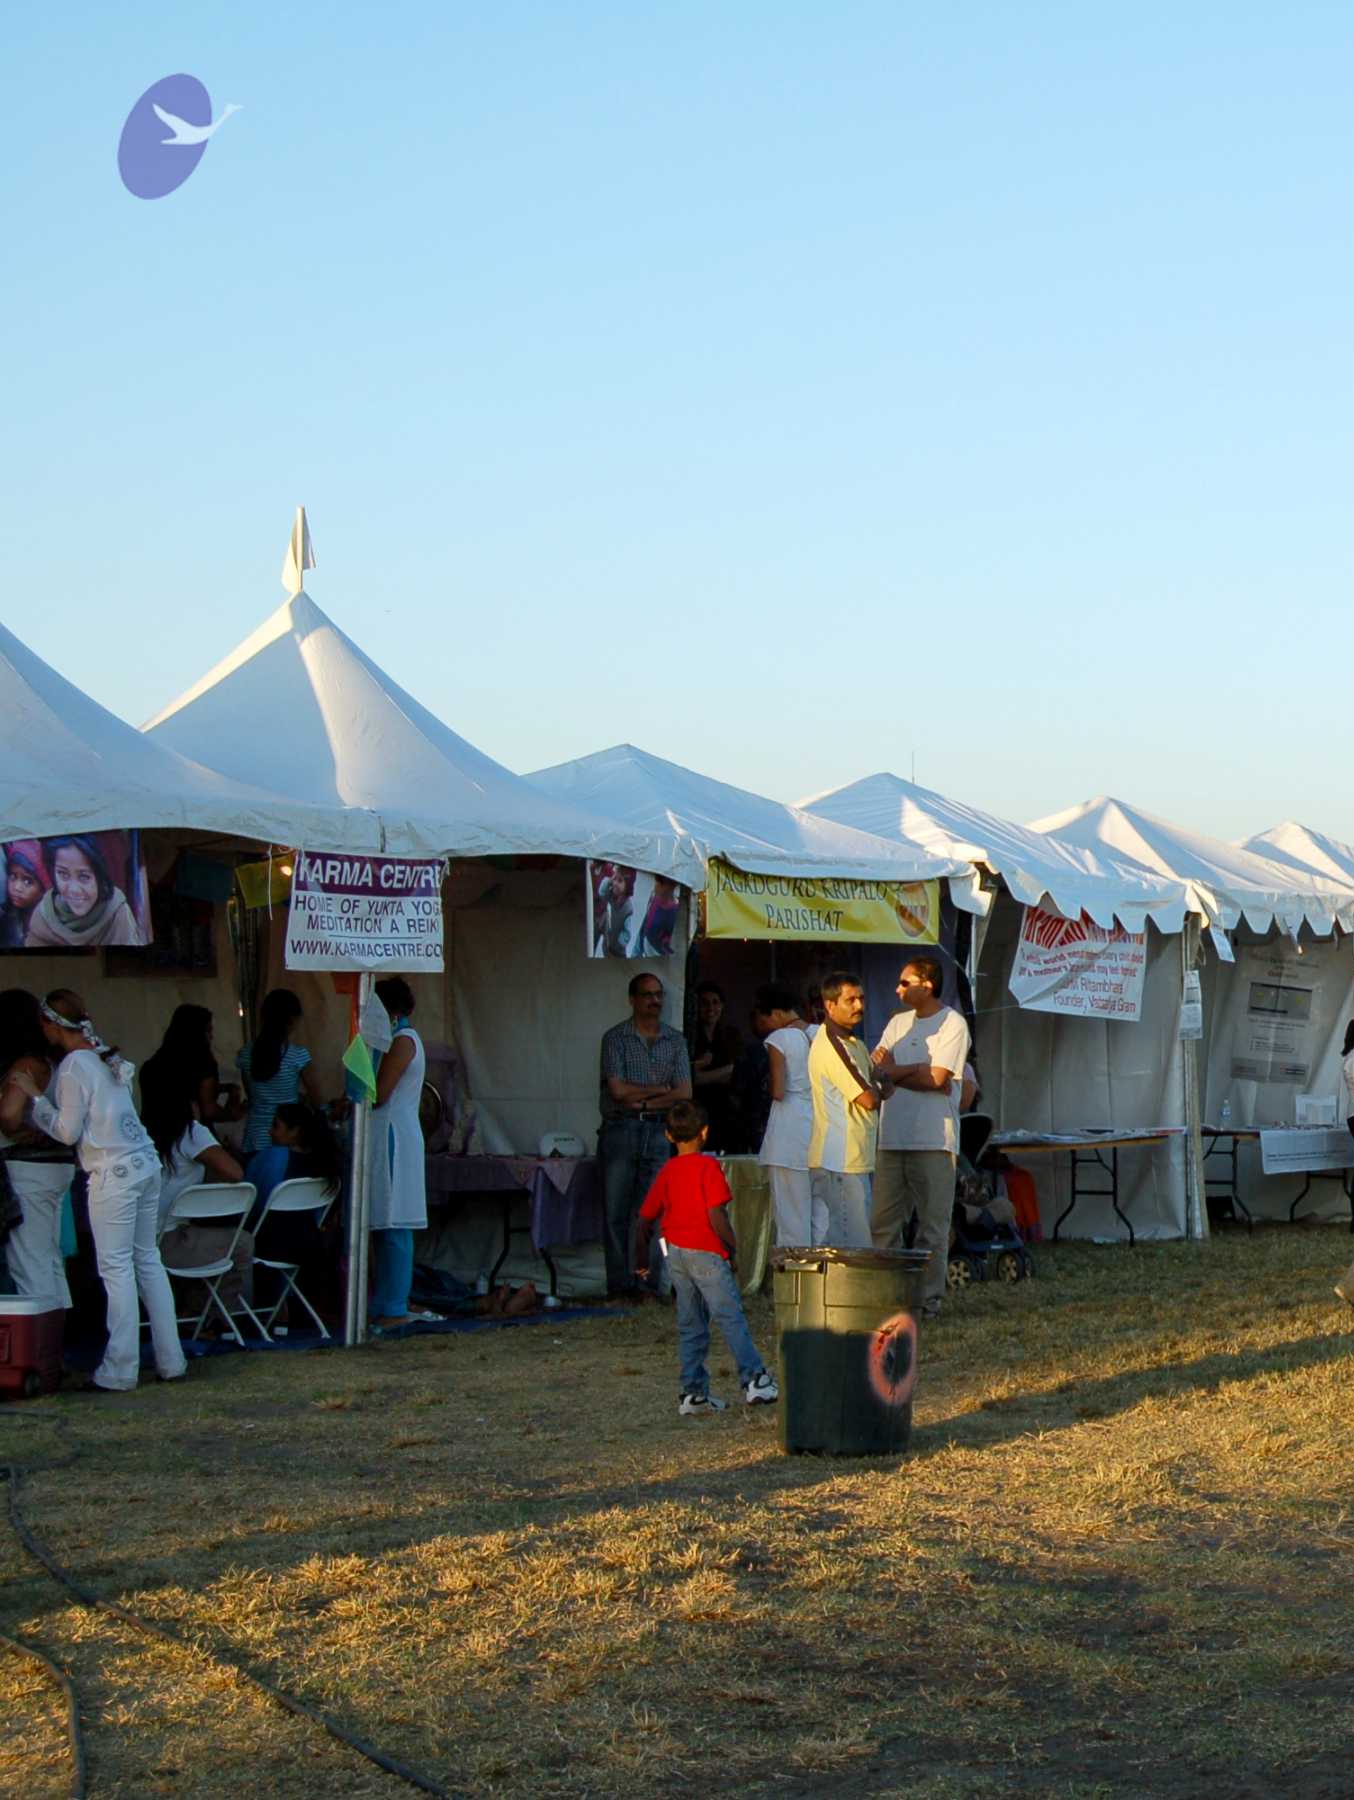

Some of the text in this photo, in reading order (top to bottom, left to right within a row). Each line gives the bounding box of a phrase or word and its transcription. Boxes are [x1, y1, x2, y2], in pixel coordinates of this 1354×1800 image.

[300, 857, 373, 887] KARMA
[294, 895, 442, 916] HOME OF YUKTA YOG
[765, 903, 844, 932] PARISHAT
[307, 914, 382, 933] MEDITATION
